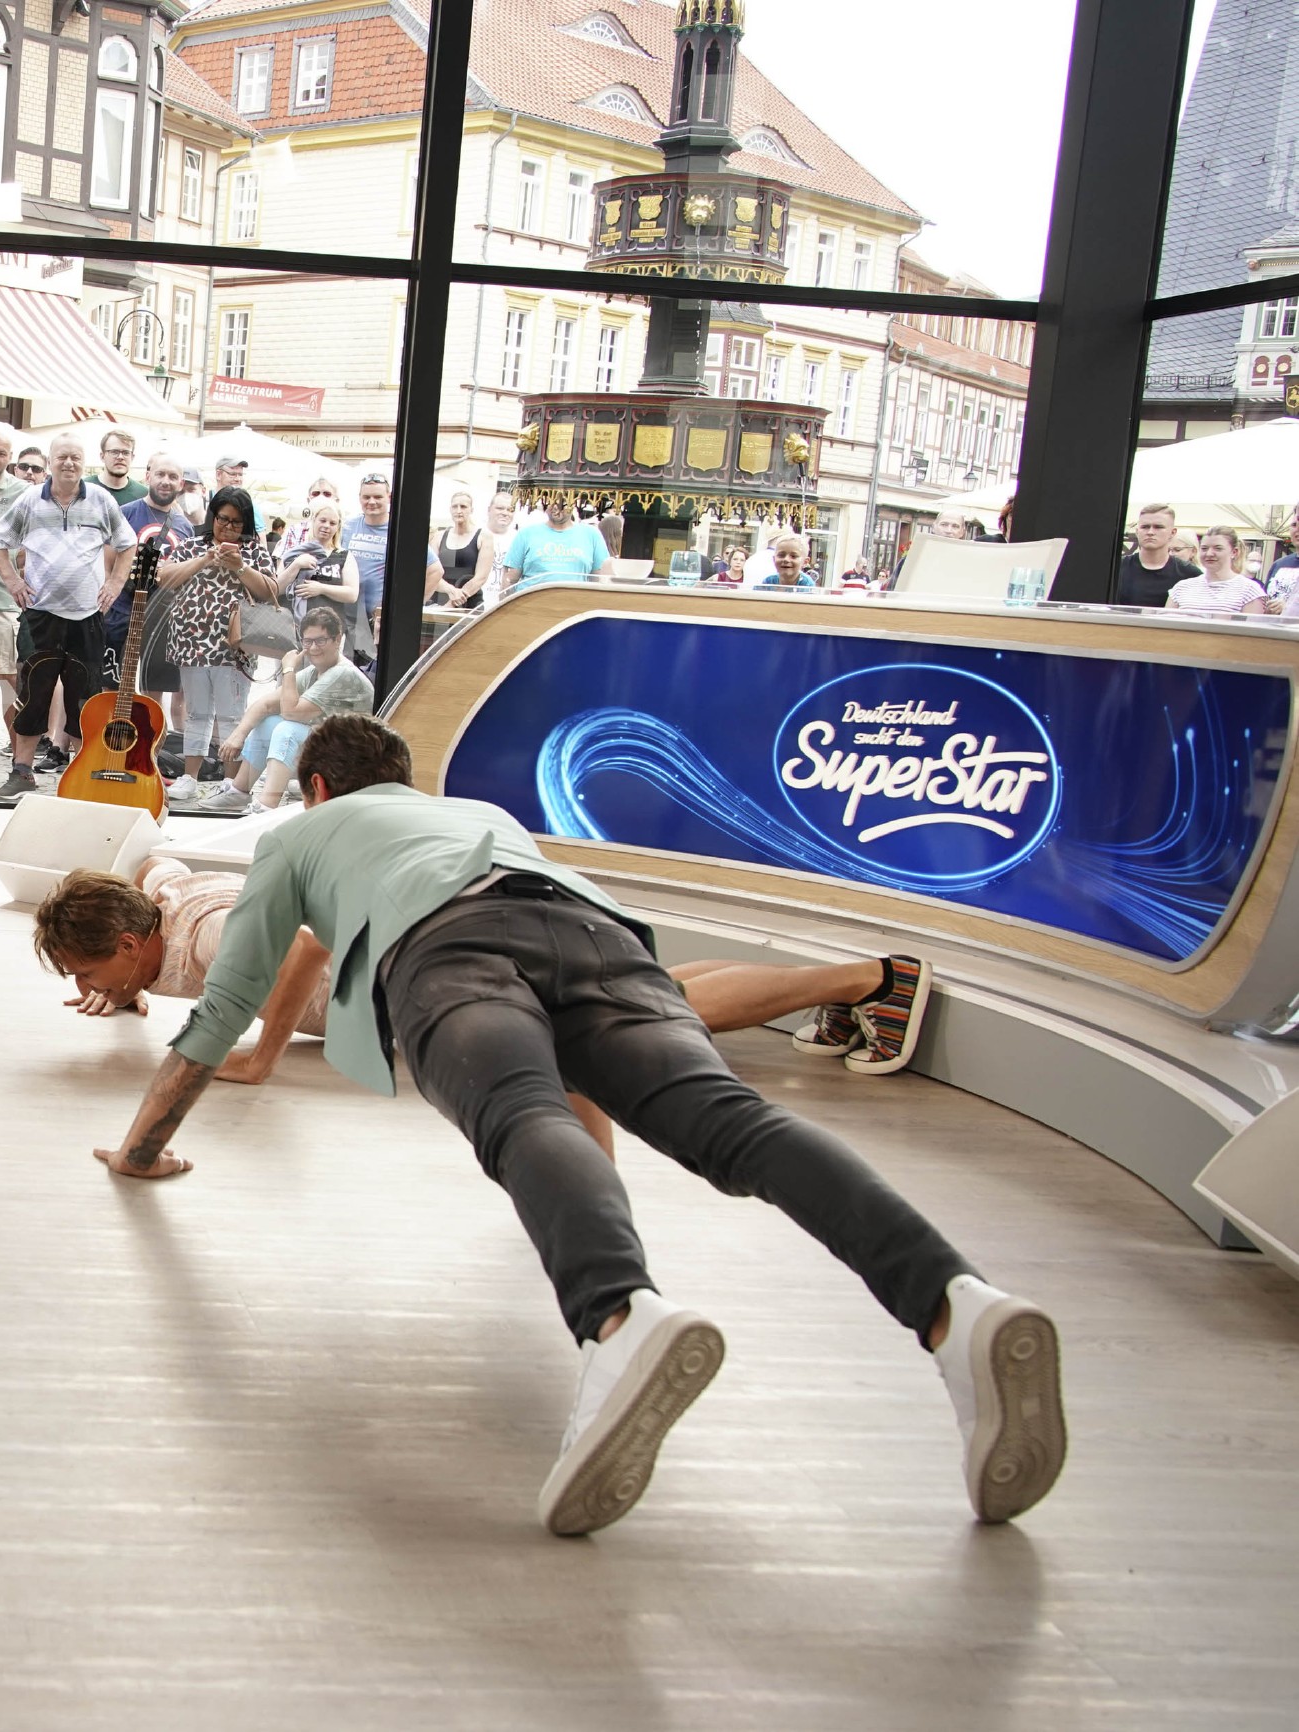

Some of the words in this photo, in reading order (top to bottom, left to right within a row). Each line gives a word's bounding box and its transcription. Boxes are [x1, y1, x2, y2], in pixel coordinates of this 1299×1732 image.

[212, 392, 249, 405] REMISE
[215, 381, 283, 399] TESTZENTRUM
[280, 434, 320, 448] Galerie
[325, 435, 339, 448] im
[342, 436, 380, 449] Ersten
[841, 700, 959, 726] Deutschland
[853, 727, 896, 746] sucht
[895, 728, 925, 747] den
[781, 719, 1049, 827] SuperStar
